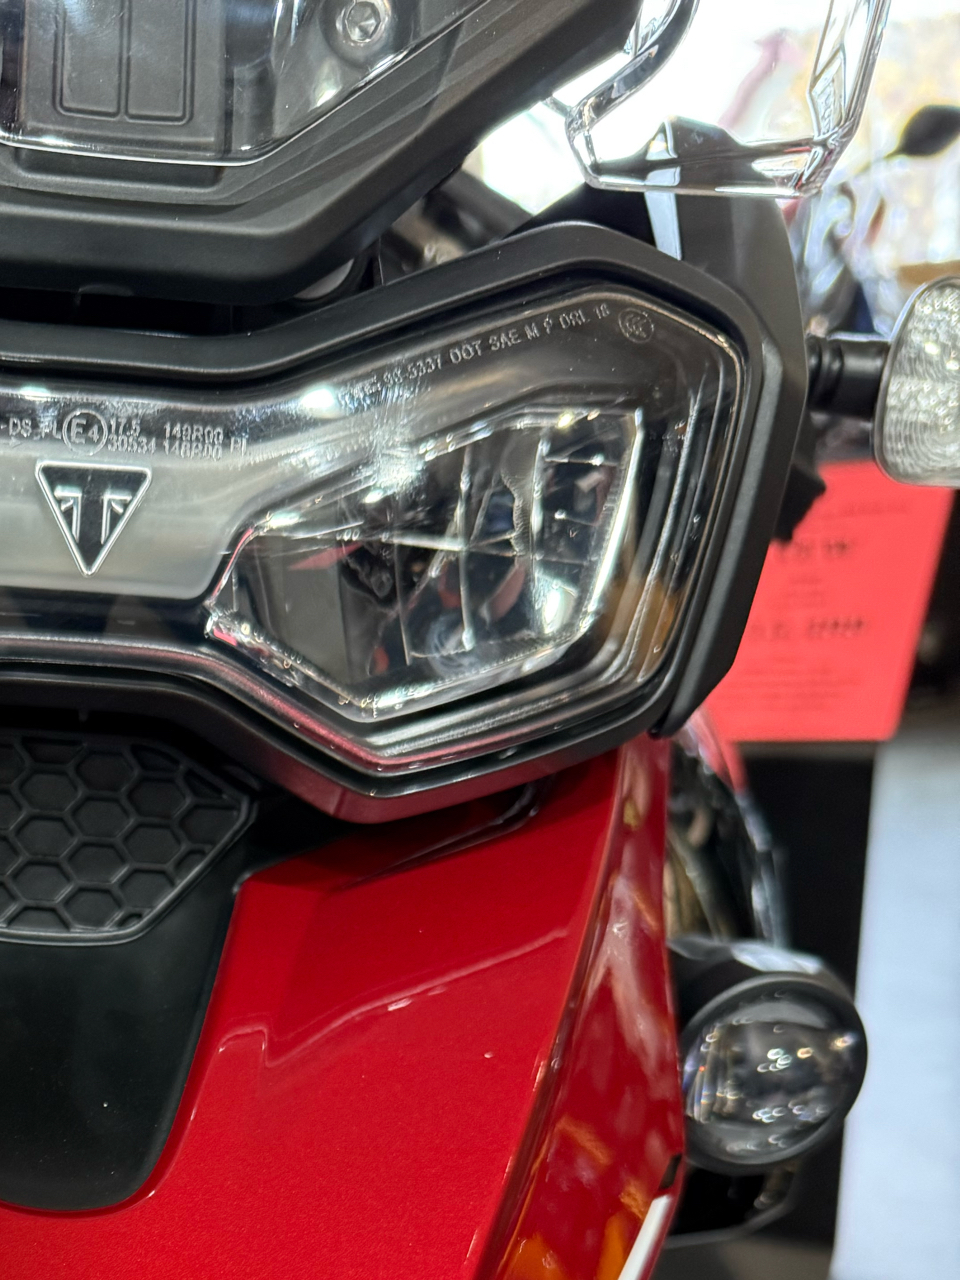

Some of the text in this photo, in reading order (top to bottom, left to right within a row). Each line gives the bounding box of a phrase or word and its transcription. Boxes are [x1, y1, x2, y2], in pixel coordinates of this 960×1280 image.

[448, 338, 483, 365] DOT
[489, 328, 522, 352] SAE
[524, 321, 541, 341] M
